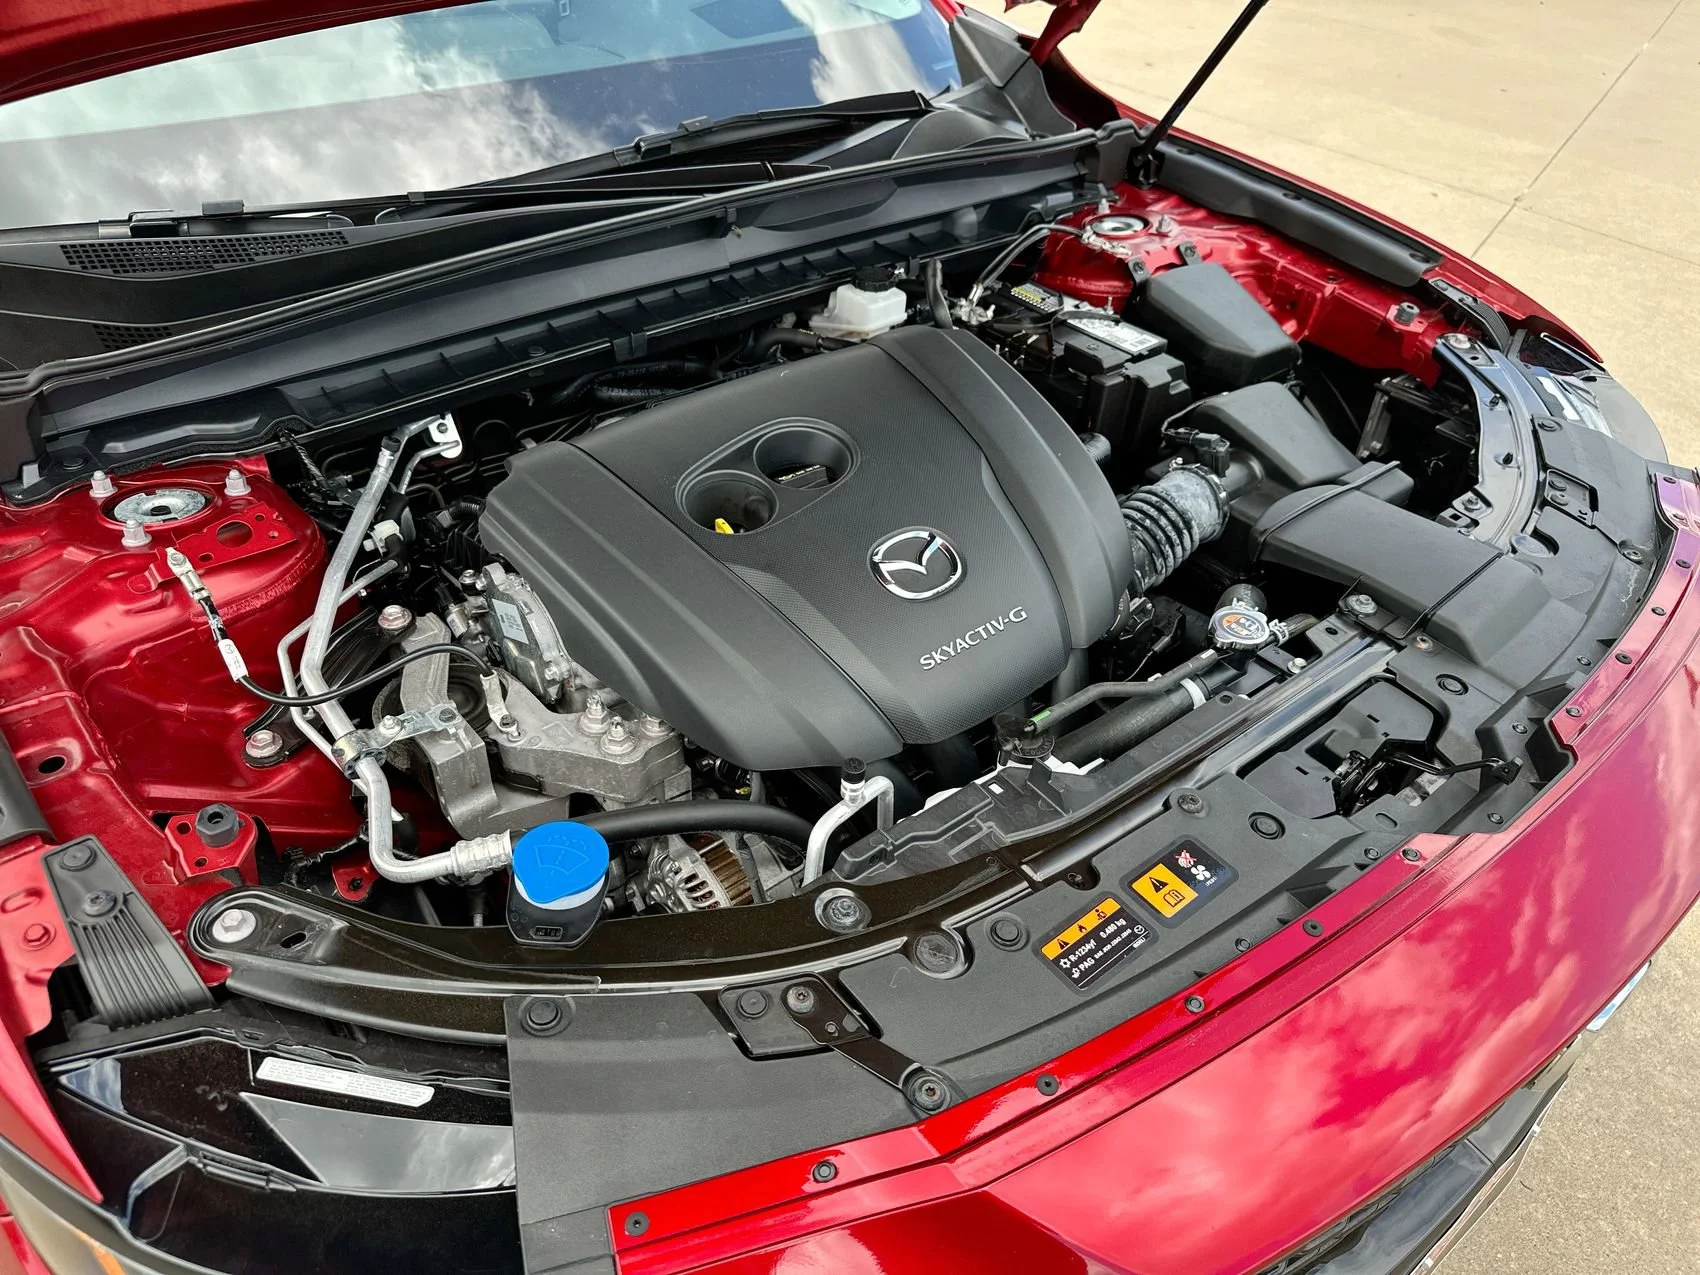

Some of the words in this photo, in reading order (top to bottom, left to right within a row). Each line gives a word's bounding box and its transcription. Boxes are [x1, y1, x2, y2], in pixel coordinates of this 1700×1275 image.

[920, 606, 1028, 670] SKYACTIV-G
[1069, 938, 1097, 962] R-1234yf
[1115, 917, 1127, 928] kg
[1079, 957, 1095, 972] PAG
